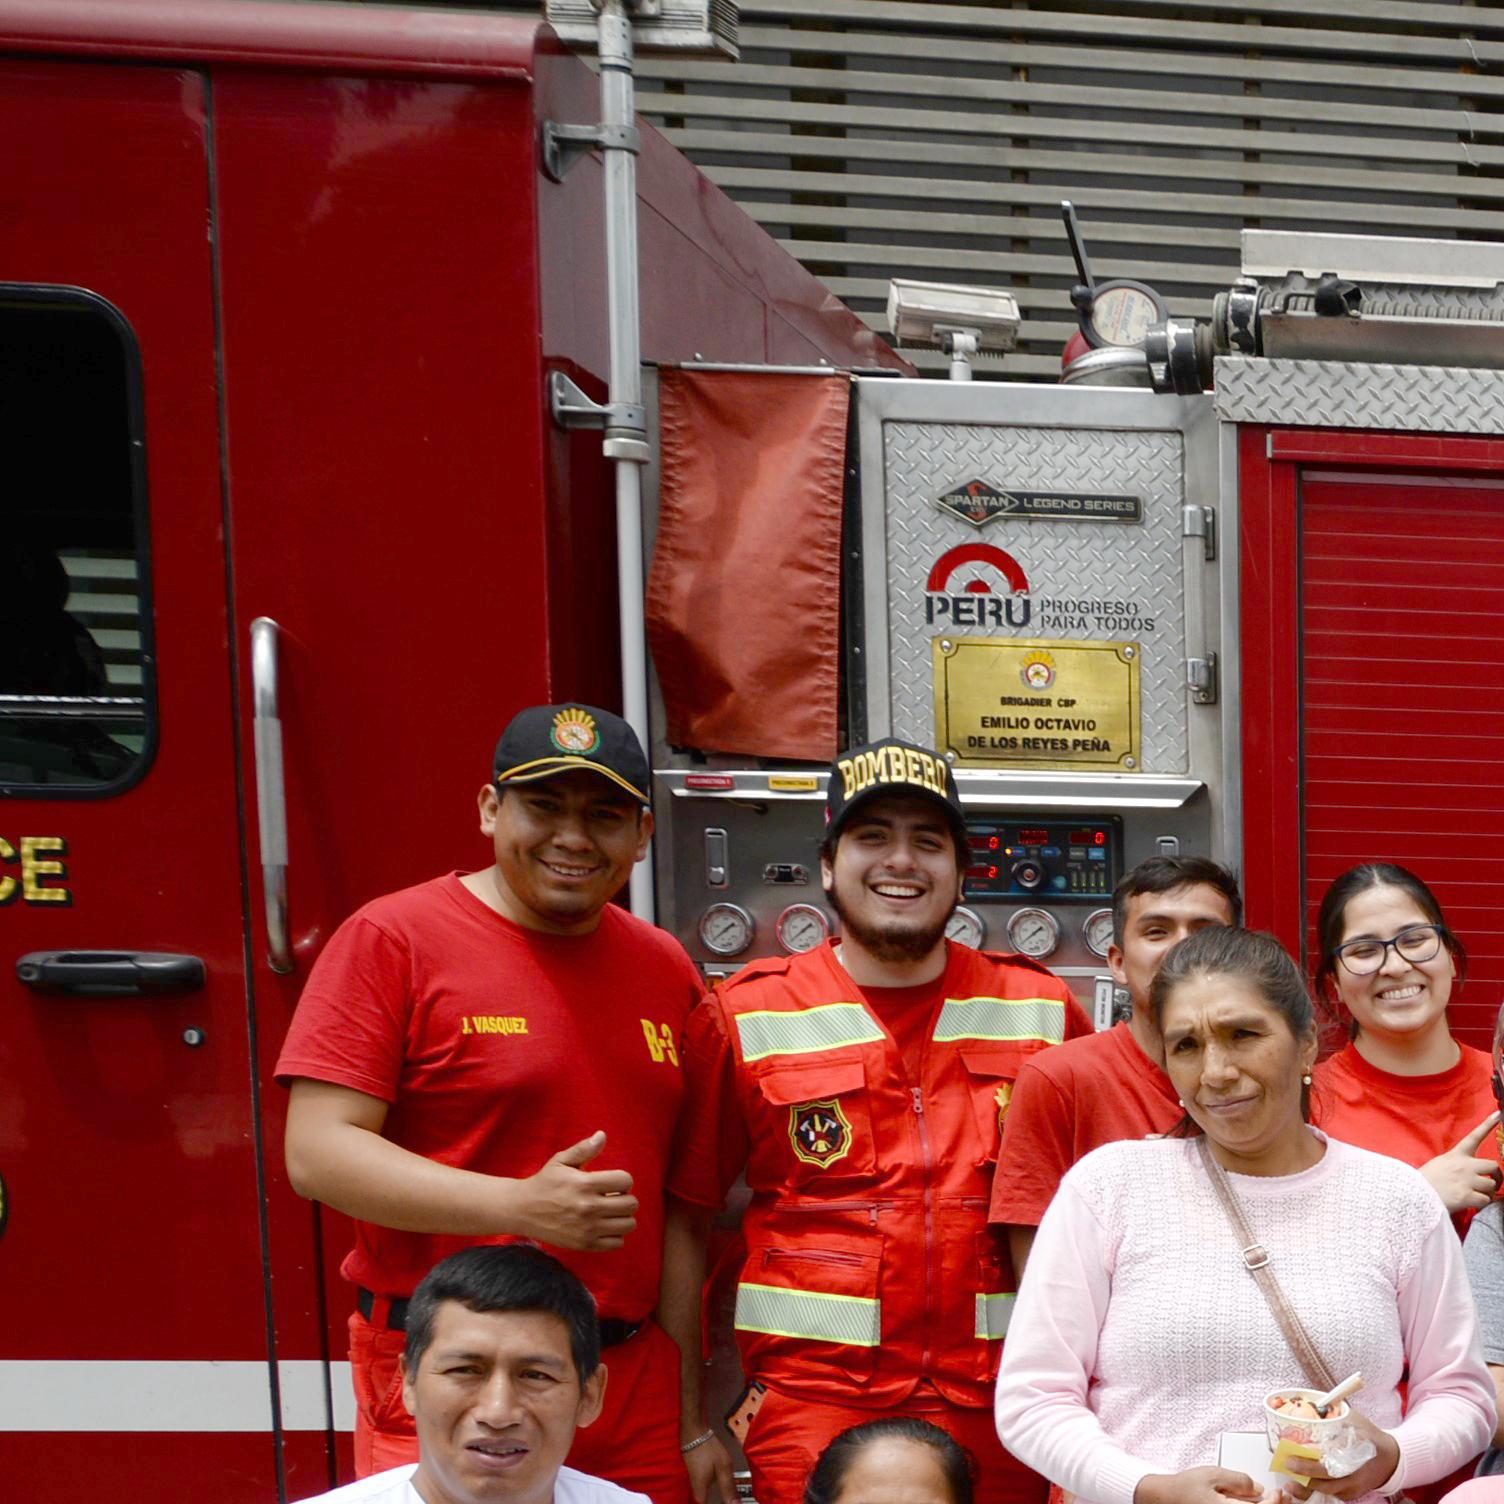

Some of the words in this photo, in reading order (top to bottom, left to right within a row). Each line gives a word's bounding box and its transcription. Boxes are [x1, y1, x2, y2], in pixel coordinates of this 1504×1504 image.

[945, 495, 1009, 507] SPARTAN
[1024, 498, 1081, 509] LEGEND
[1084, 499, 1135, 511] SERIES
[1040, 599, 1139, 616] PROGRESO
[1040, 615, 1088, 630] PARA
[1094, 616, 1155, 632] TODOS
[1000, 696, 1052, 707] BRIGADIER
[1057, 698, 1076, 708] CBP
[981, 716, 1030, 730] EMILIO
[1034, 717, 1096, 731] OCTAVIO
[968, 736, 986, 748] DE
[990, 736, 1018, 749] LOS
[1022, 737, 1069, 750] REYES
[1072, 736, 1111, 752] PEÑA
[462, 1016, 473, 1034] J.
[473, 1016, 529, 1035] VASQUEZ
[640, 1018, 679, 1067] B-3
